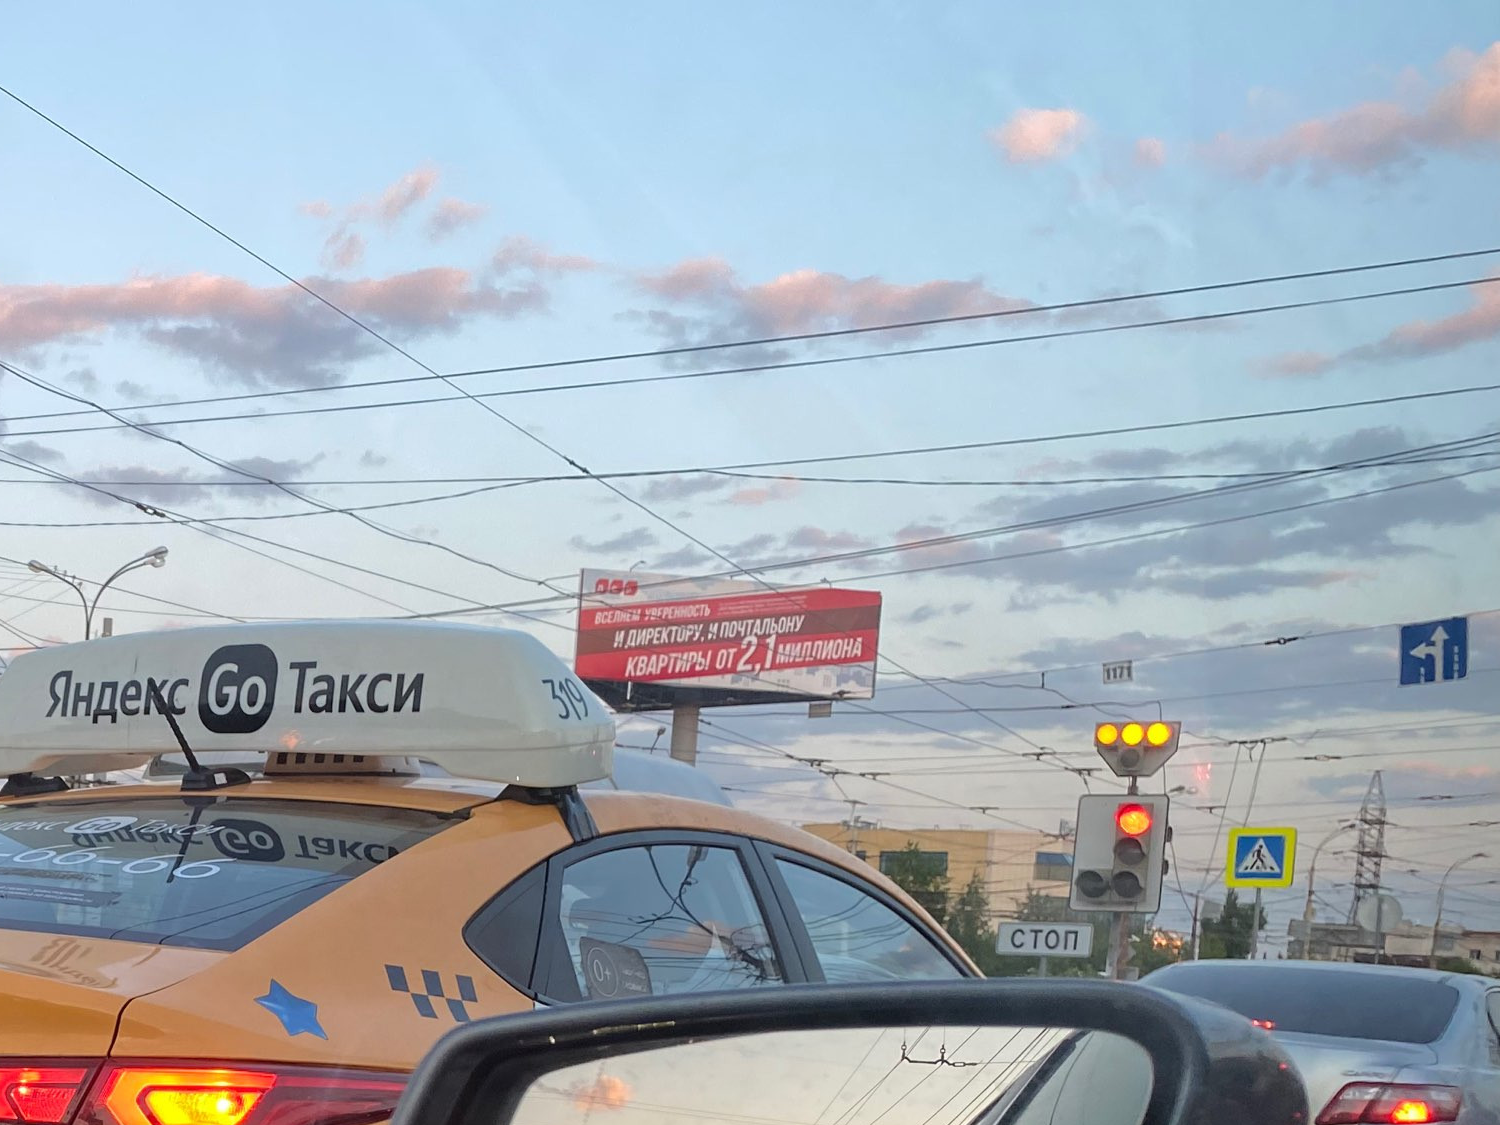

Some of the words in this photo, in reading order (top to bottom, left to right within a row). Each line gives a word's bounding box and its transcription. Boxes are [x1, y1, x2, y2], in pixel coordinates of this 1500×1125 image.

[613, 630, 624, 648] И
[624, 623, 704, 649] ДИРЕКТОРУ,
[708, 622, 717, 641] И
[719, 615, 805, 639] ПОЧТАЛЬОНУ
[625, 650, 711, 678] КВАРТИРЫ
[716, 648, 737, 670] ОТ
[737, 635, 777, 676] 2,1
[776, 637, 863, 665] МИЛЛИОНА
[1105, 665, 1132, 680] 1171
[44, 669, 190, 724] Яндекс
[207, 662, 268, 717] Go
[289, 660, 425, 714] Такси
[541, 677, 589, 720] 319
[131, 818, 227, 836] Такси
[1010, 928, 1079, 950] СТОП
